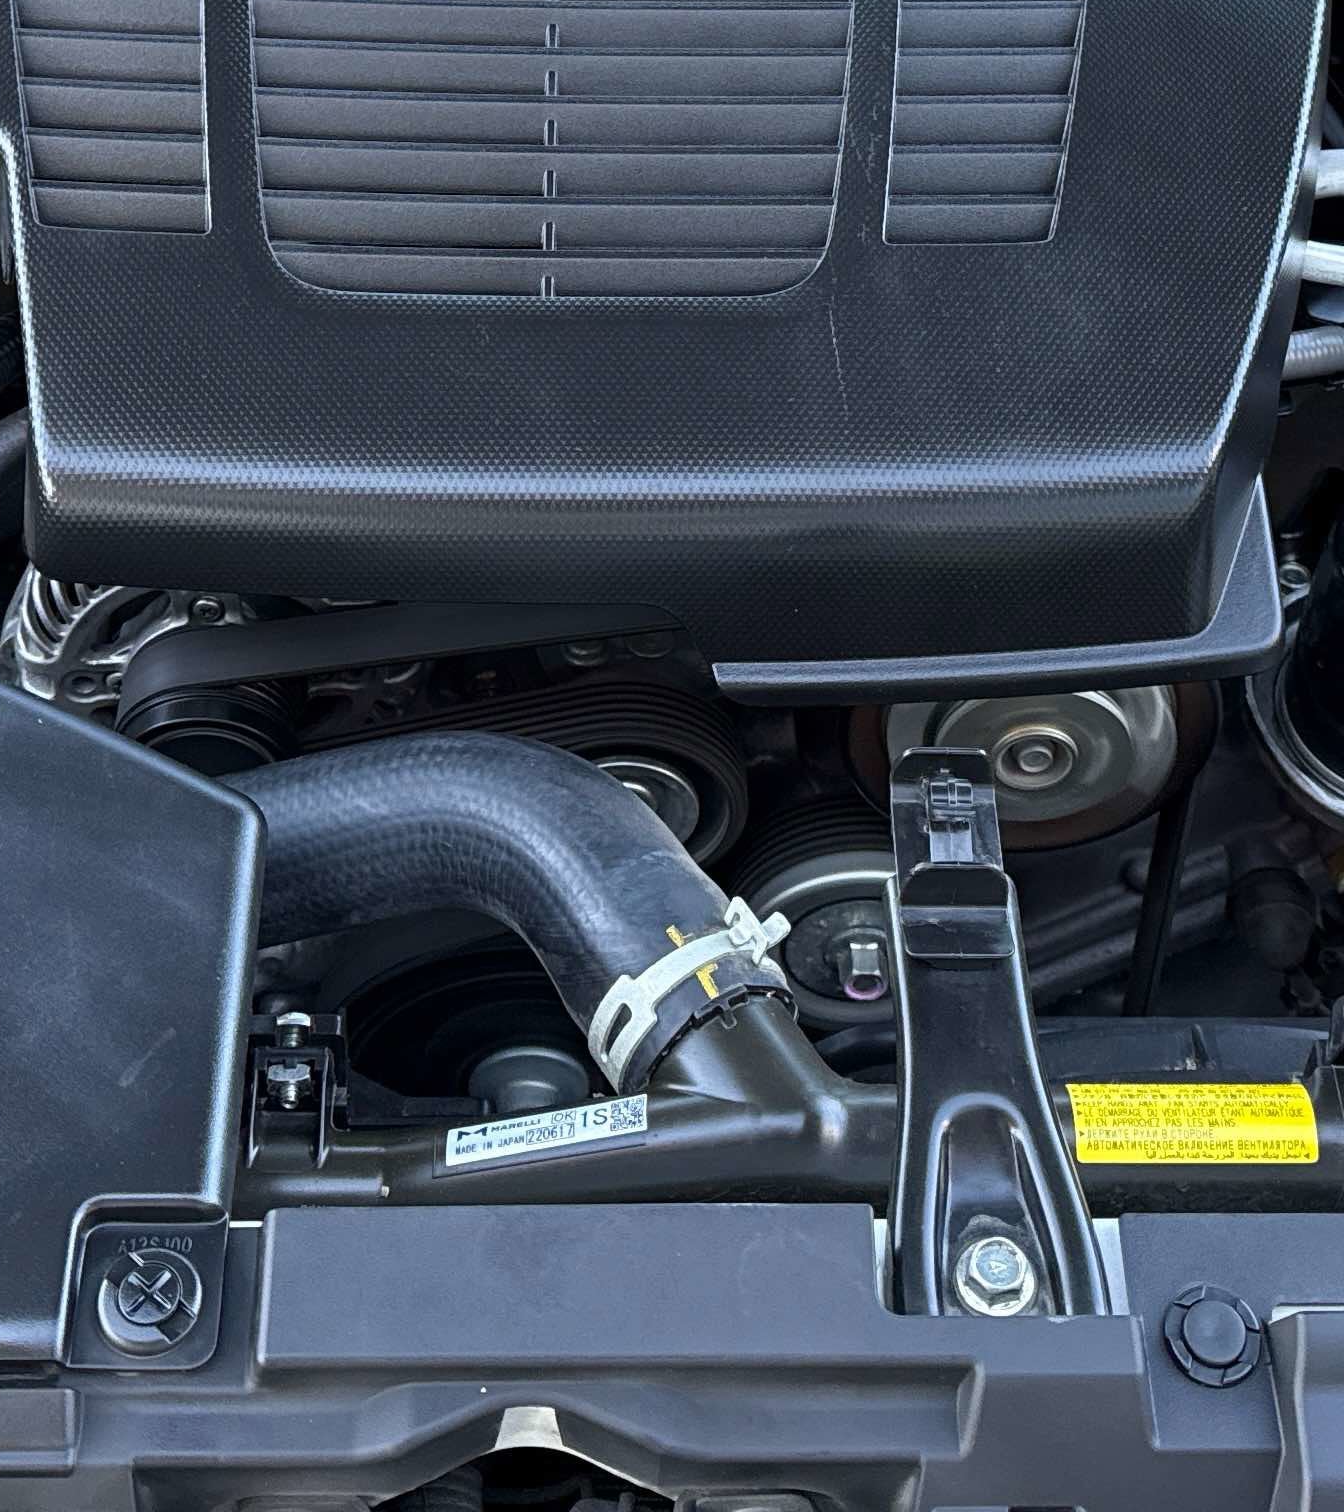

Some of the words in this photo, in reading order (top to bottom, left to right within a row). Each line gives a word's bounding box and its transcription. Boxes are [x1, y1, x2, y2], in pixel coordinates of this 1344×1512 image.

[1165, 1118, 1183, 1128] PAS
[1187, 1118, 1204, 1128] LES
[498, 1136, 525, 1148] JAPAN
[528, 1123, 573, 1143] 220617
